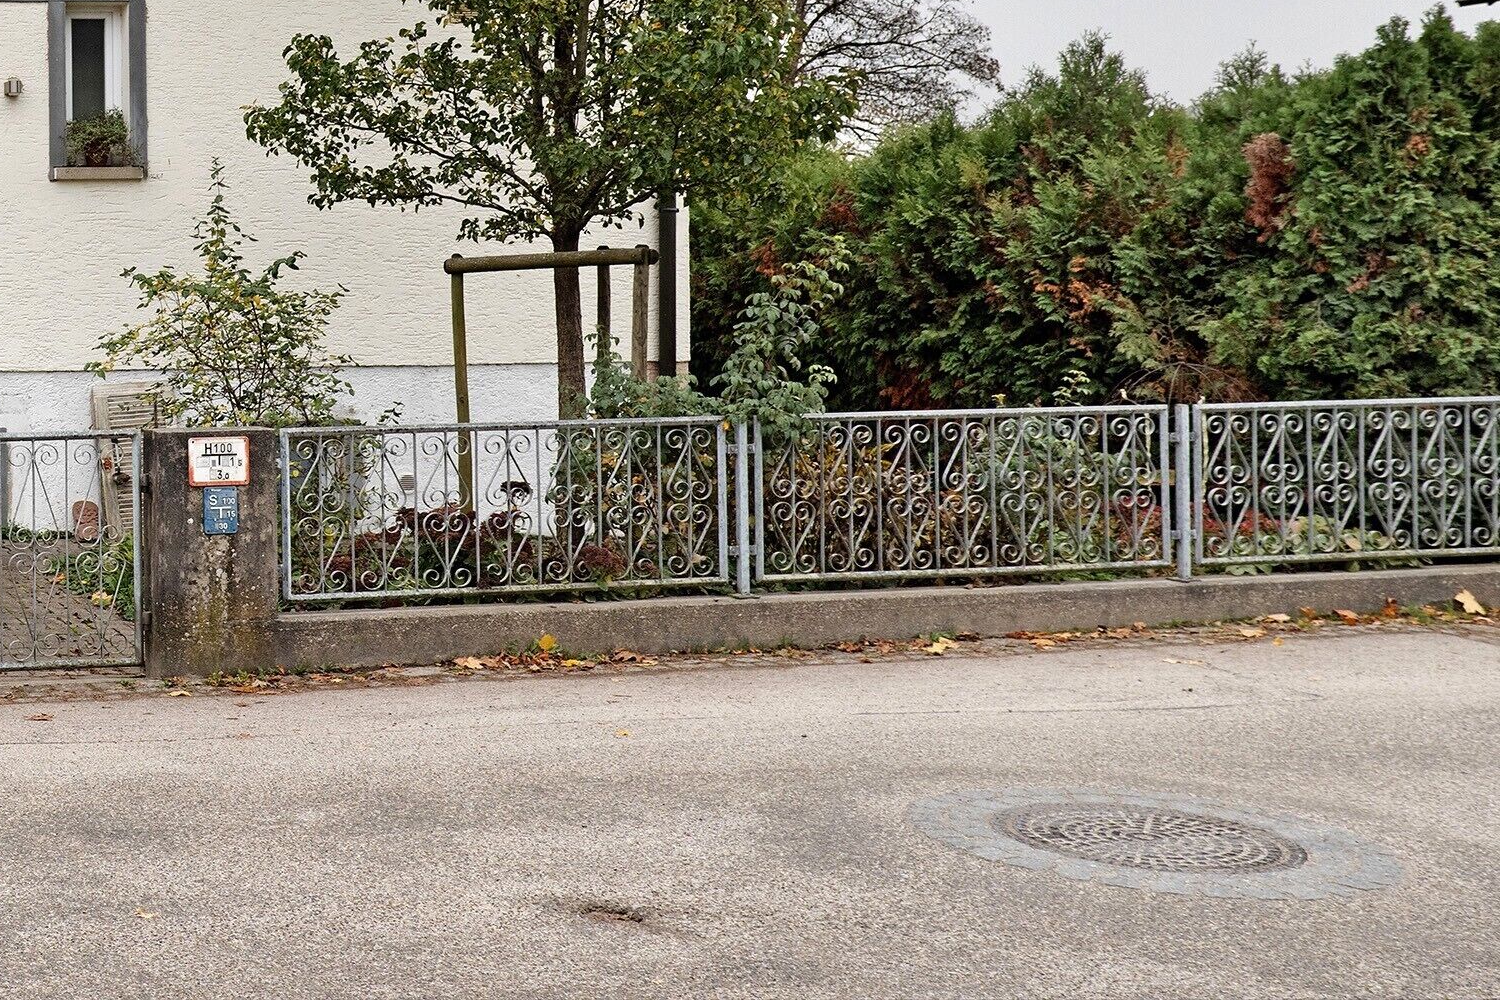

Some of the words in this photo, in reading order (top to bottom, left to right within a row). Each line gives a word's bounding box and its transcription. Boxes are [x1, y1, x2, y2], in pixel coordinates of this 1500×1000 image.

[204, 442, 233, 454] H100
[209, 494, 218, 506] S
[222, 497, 236, 505] 100
